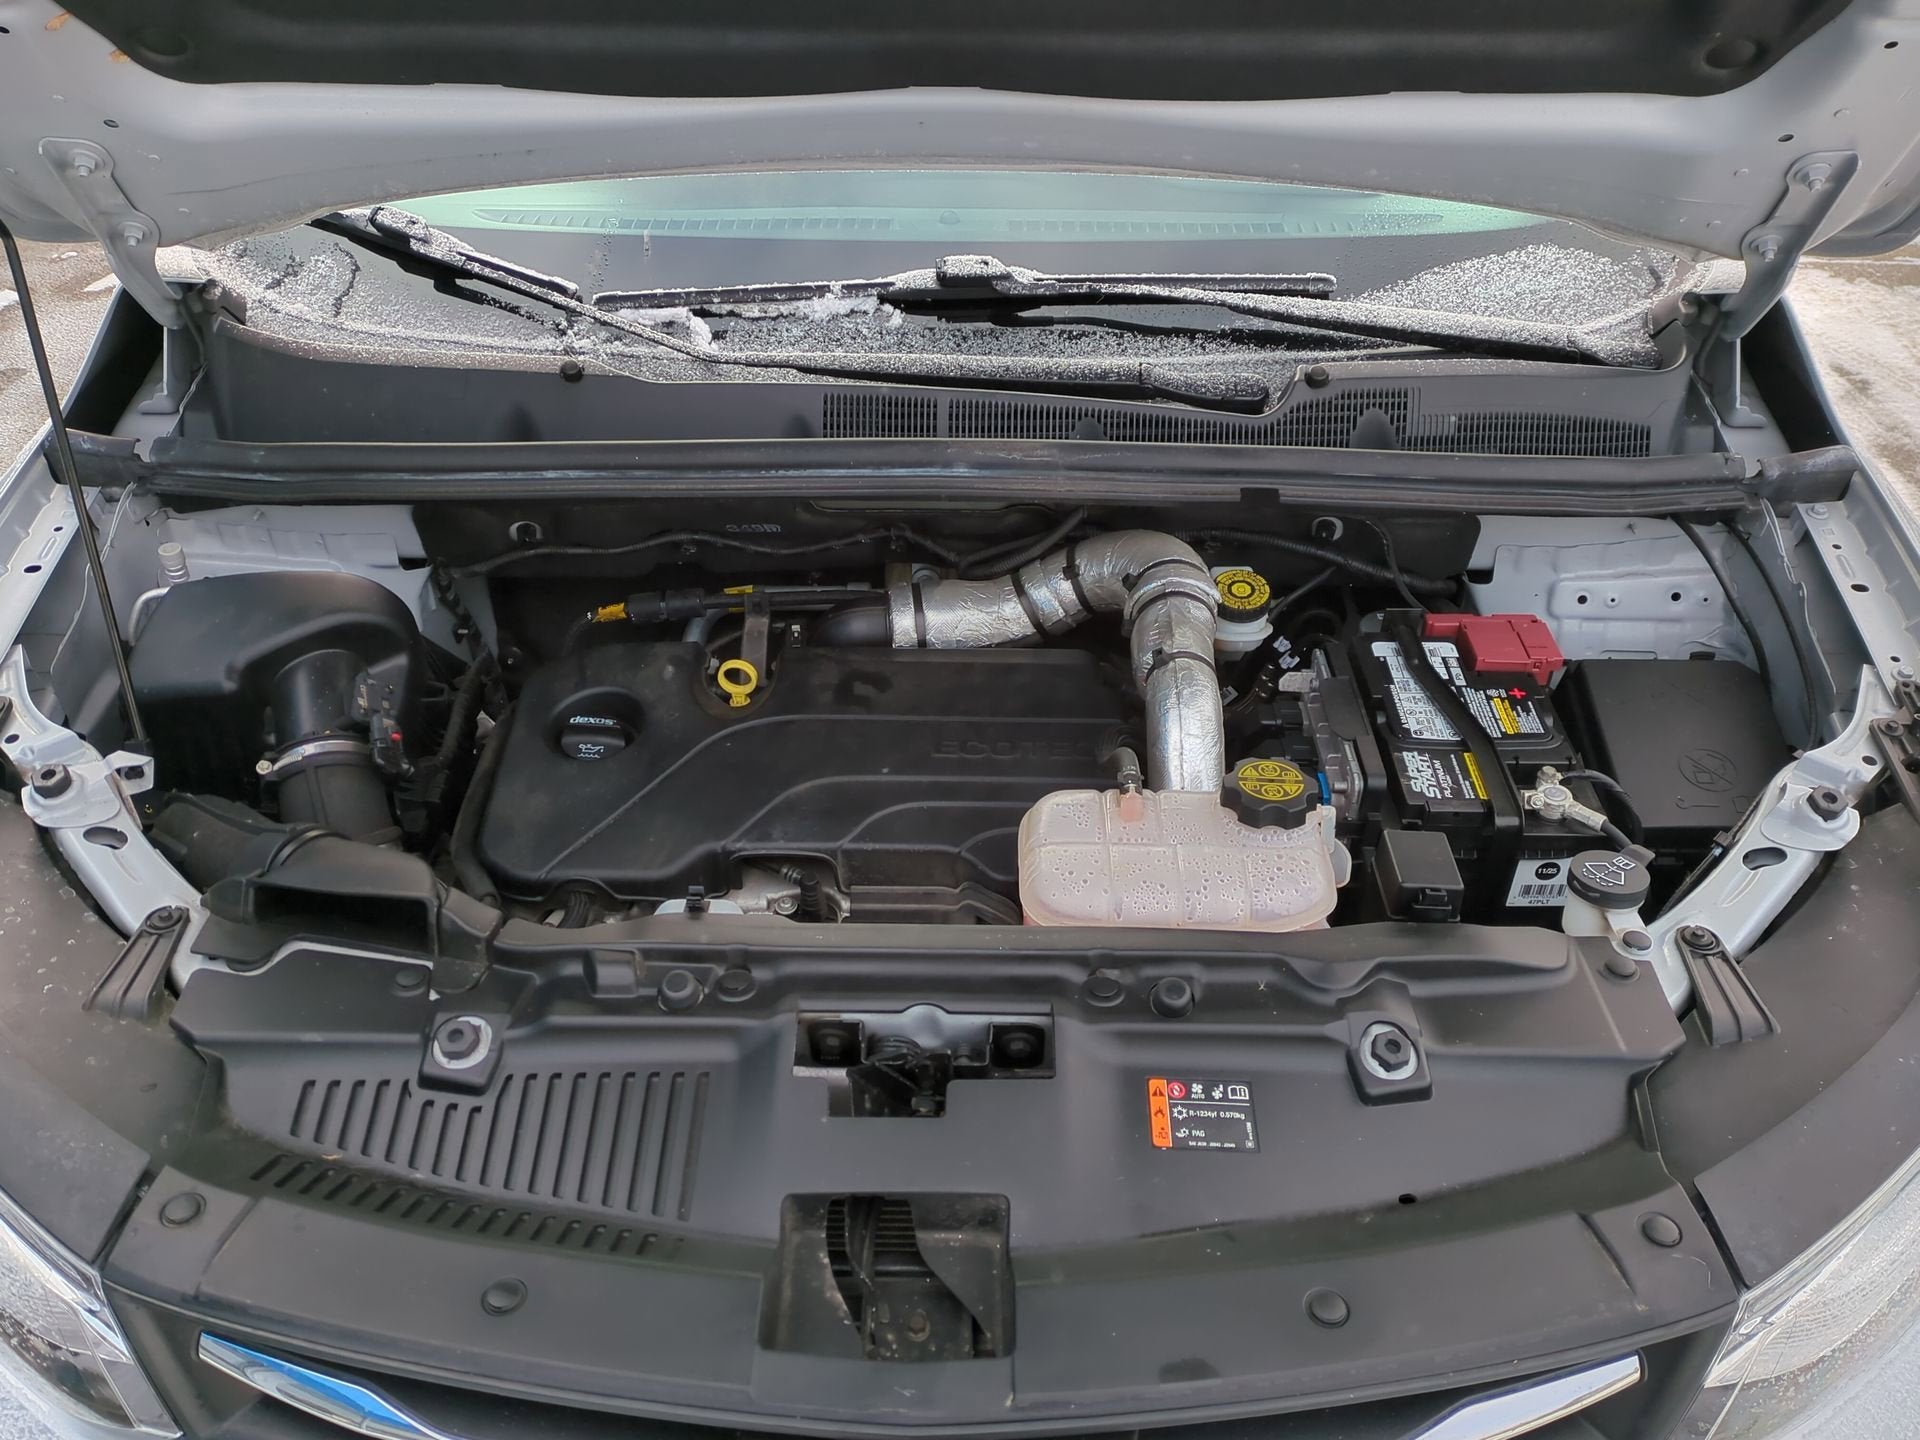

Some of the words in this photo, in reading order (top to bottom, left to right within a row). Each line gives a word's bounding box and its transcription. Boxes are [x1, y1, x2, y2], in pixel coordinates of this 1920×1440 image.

[569, 715, 614, 725] dexos
[1402, 751, 1421, 792] SUPER
[1419, 754, 1442, 799] START
[1433, 760, 1453, 798] PLATINUM
[1189, 1110, 1217, 1118] R-1234yf
[1220, 1111, 1245, 1120] 0.570kg
